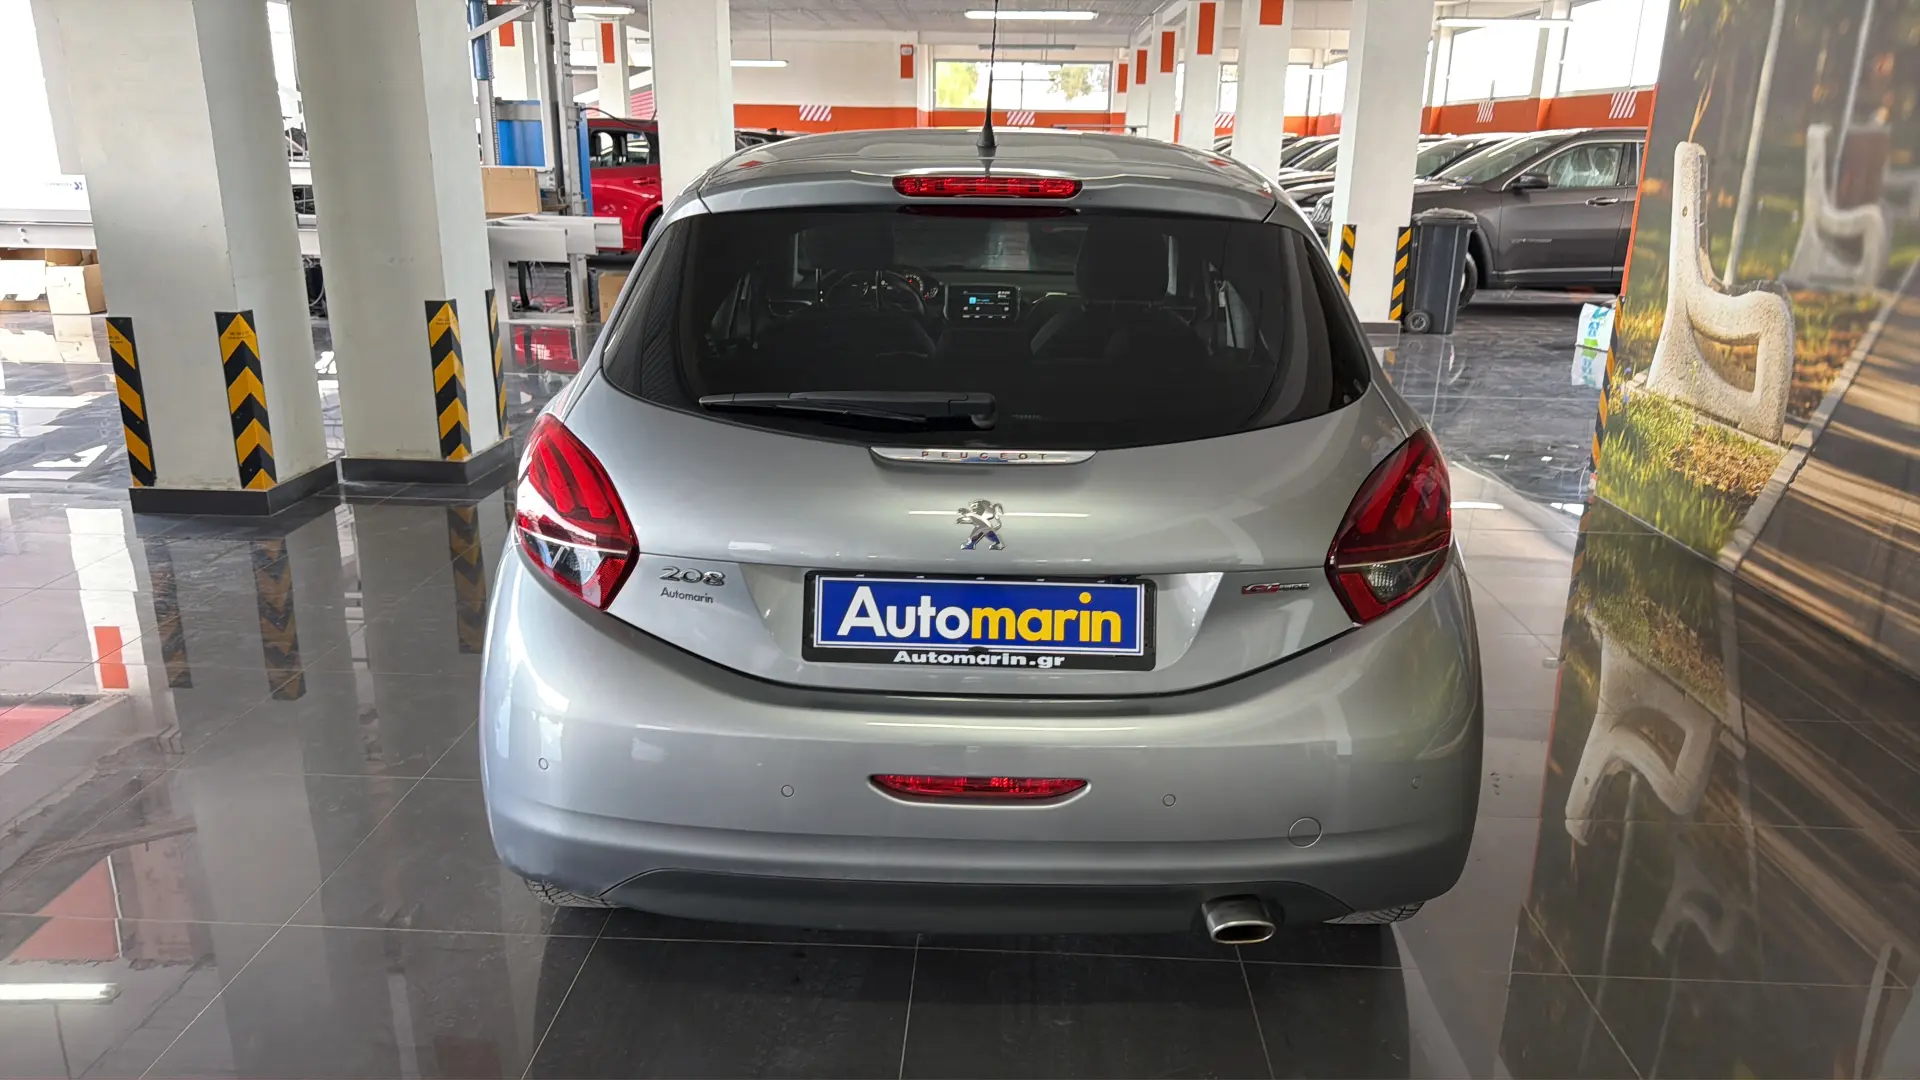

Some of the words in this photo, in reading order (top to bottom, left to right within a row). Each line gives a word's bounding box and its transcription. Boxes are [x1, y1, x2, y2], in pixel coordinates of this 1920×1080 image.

[921, 452, 1048, 460] PEUGEOT
[659, 565, 726, 587] 208
[660, 586, 714, 604] Automarin
[836, 585, 1122, 643] Automarin
[892, 649, 1066, 669] Automarin.gr
